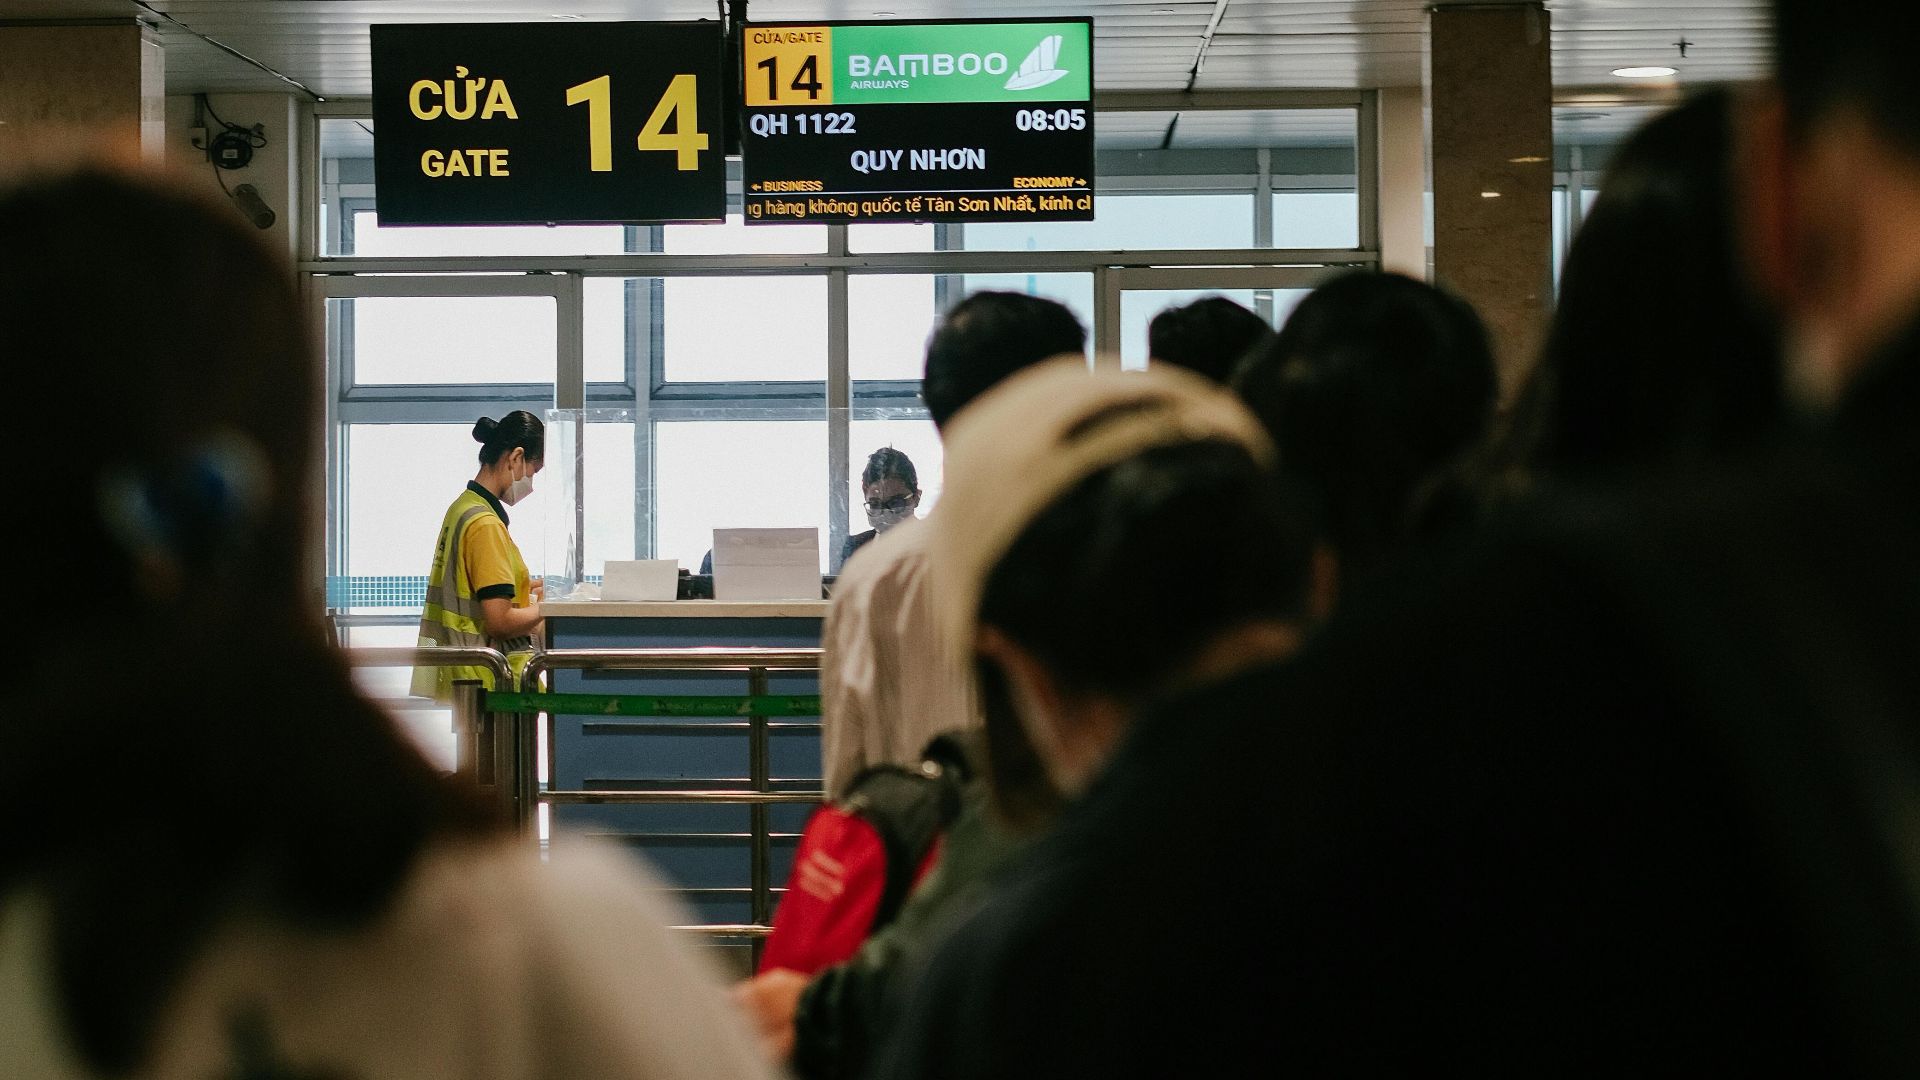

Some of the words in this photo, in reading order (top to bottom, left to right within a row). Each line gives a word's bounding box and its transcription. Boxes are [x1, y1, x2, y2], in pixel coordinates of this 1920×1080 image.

[753, 29, 824, 45] CỬA/GATE
[757, 54, 823, 101] 14
[848, 52, 1008, 78] BAMBOO
[408, 65, 519, 121] CỬA
[850, 79, 910, 90] AIRWAYS
[565, 74, 709, 172] 14
[750, 113, 788, 137] QH
[794, 112, 857, 135] 1122
[1015, 109, 1087, 131] 08:05
[420, 149, 510, 178] GATE
[850, 149, 904, 174] QUY
[910, 147, 986, 171] NHƠN
[763, 180, 824, 192] BUSINESS
[1013, 177, 1075, 188] ECONOMY
[765, 199, 806, 218] hàng
[808, 198, 859, 218] không
[861, 196, 902, 217] quốc
[905, 195, 923, 213] tế
[925, 197, 955, 212] Tân
[958, 196, 990, 212] Sơn
